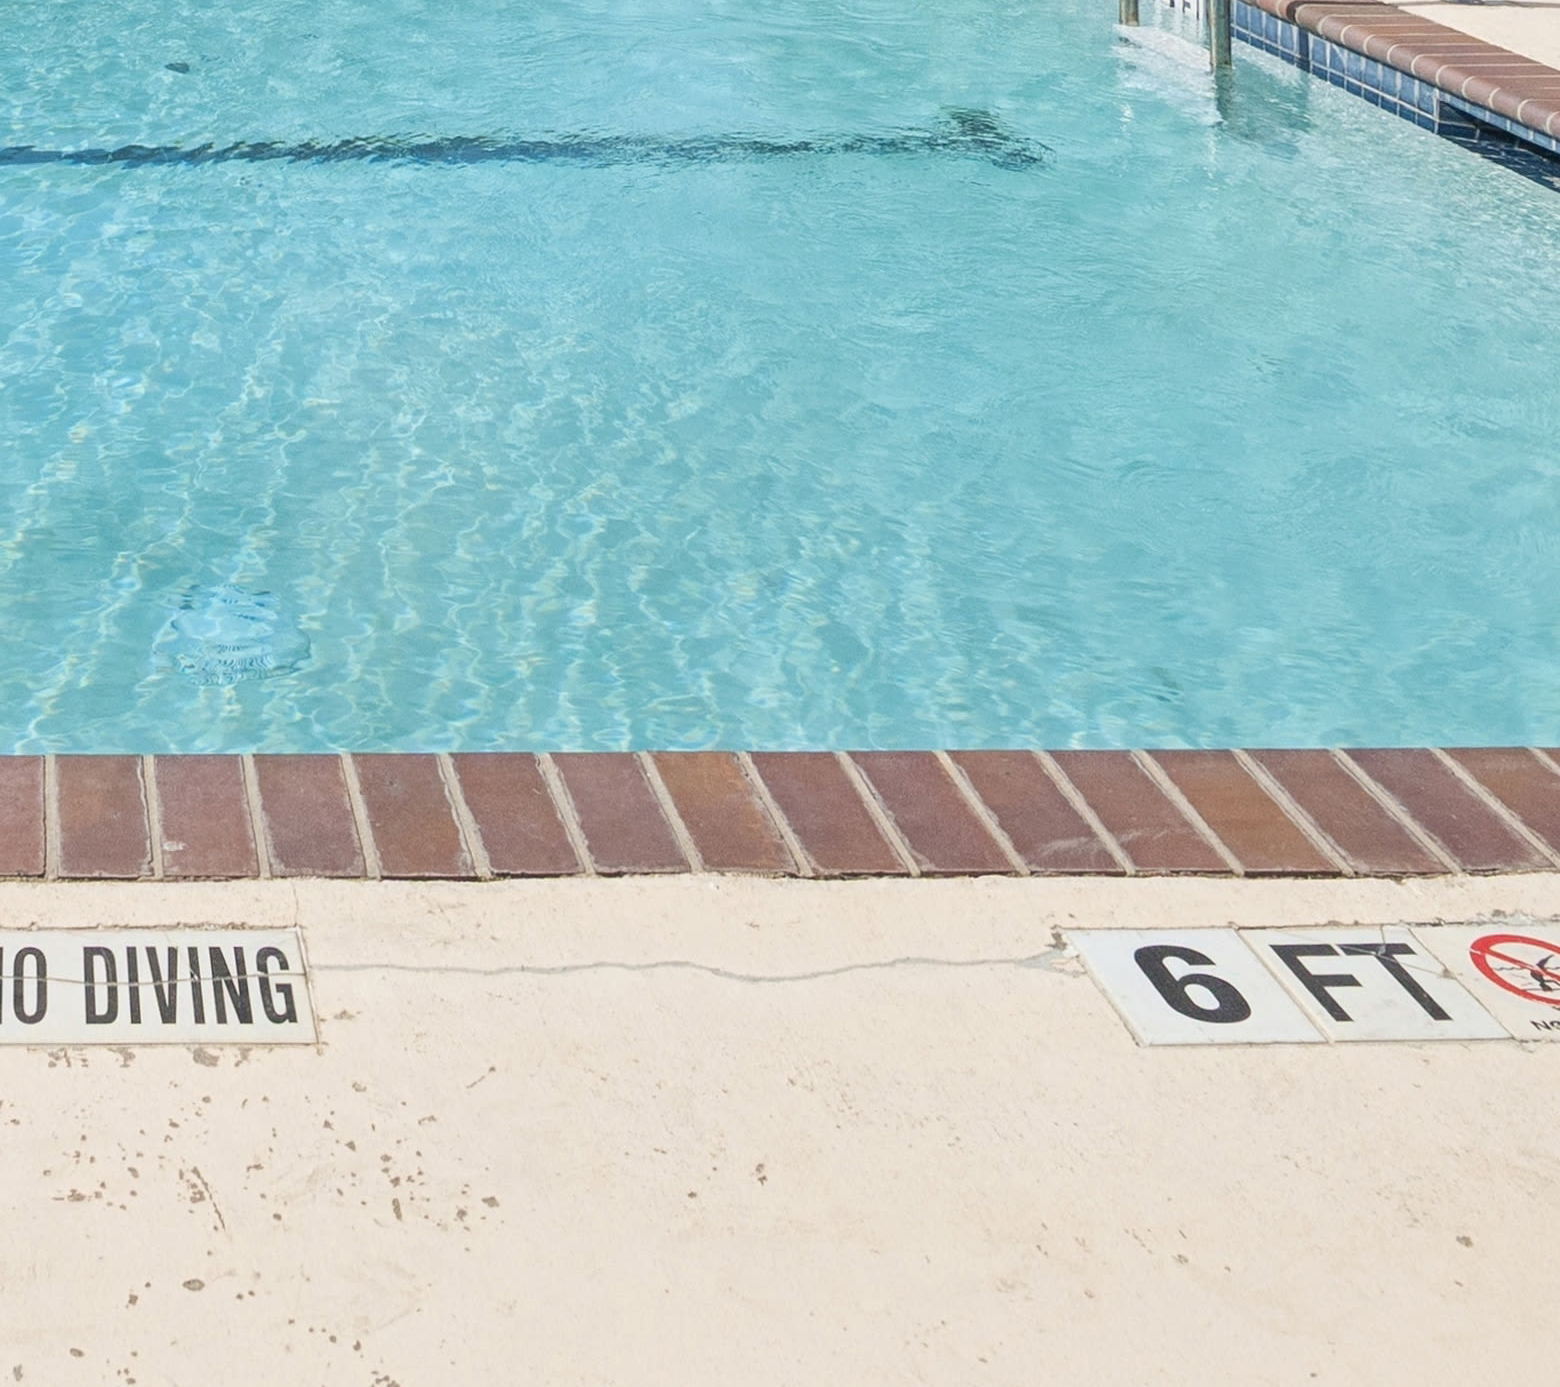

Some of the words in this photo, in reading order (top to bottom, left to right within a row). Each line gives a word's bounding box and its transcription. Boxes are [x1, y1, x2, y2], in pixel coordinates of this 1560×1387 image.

[83, 946, 298, 1025] DIVING
[1134, 944, 1251, 1024] 6
[1270, 943, 1454, 1022] FT
